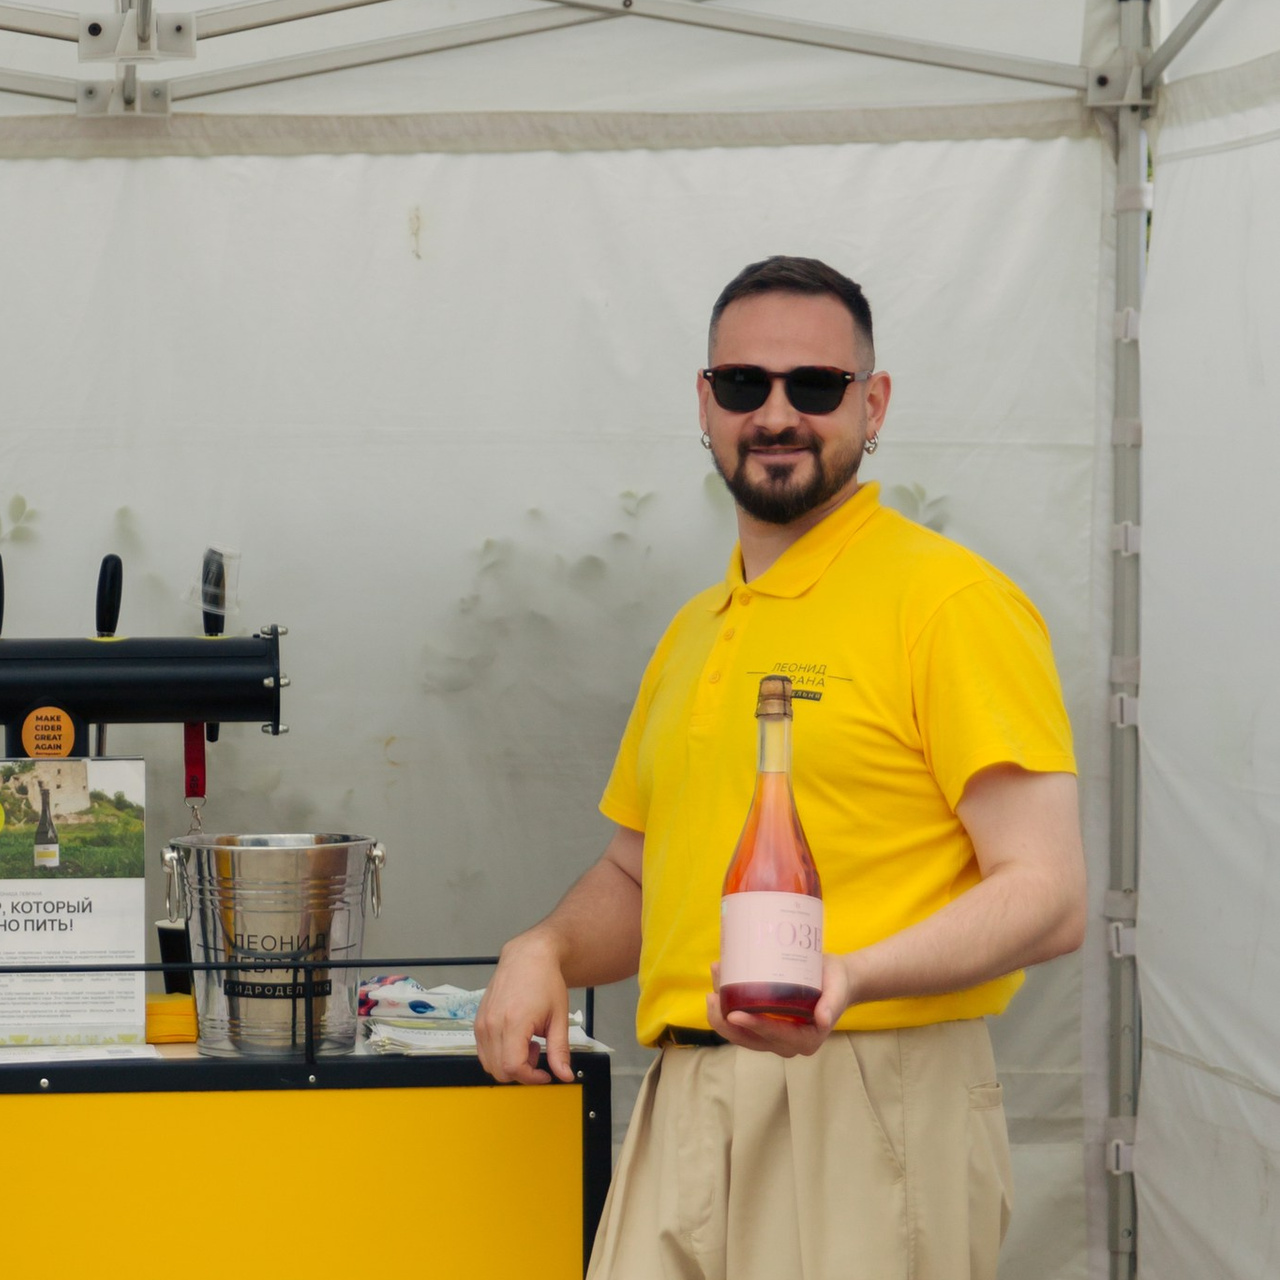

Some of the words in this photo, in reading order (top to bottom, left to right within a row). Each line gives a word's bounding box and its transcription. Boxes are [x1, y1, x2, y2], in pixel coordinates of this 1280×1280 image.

[771, 662, 827, 676] ЛЕОНИД
[11, 896, 93, 914] КОТОРЫЙ
[23, 918, 74, 932] ПИТЬ!
[233, 933, 327, 952] ЛЕОНИД
[225, 983, 330, 996] СИДРОДЕЛНЯ
